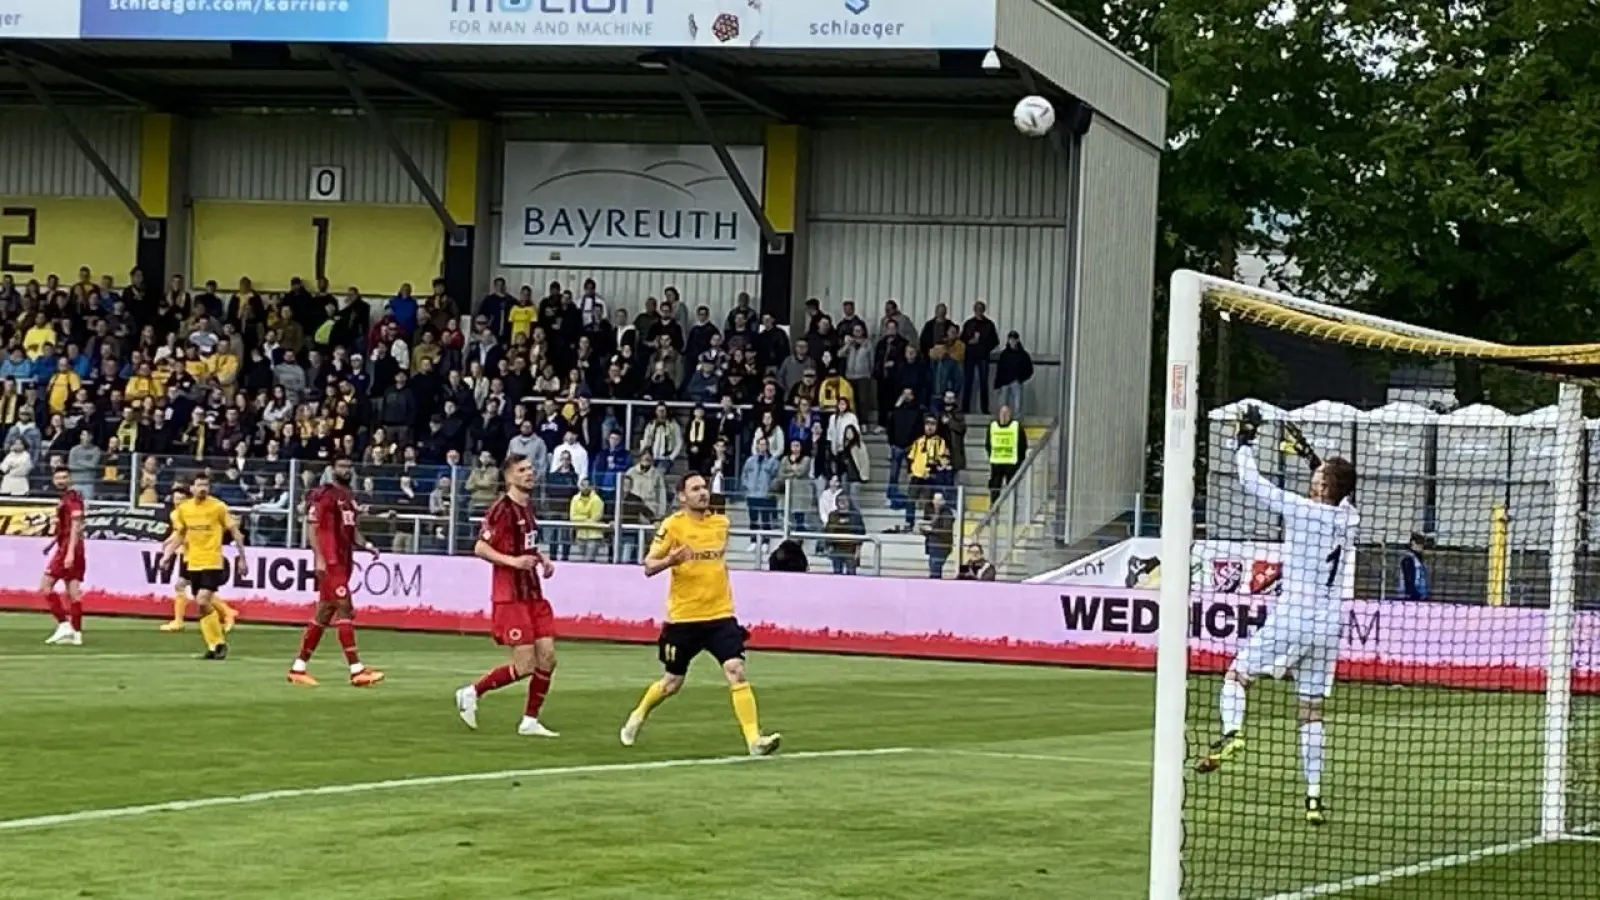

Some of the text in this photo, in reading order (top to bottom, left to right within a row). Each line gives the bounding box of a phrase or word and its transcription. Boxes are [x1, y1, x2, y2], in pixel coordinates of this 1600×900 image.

[449, 20, 654, 37] FOR MAN AND MACHINE
[809, 20, 904, 39] schlaeger
[317, 169, 335, 196] 0
[2, 207, 36, 272] 2
[312, 217, 329, 281] 1
[1326, 544, 1342, 587] 1
